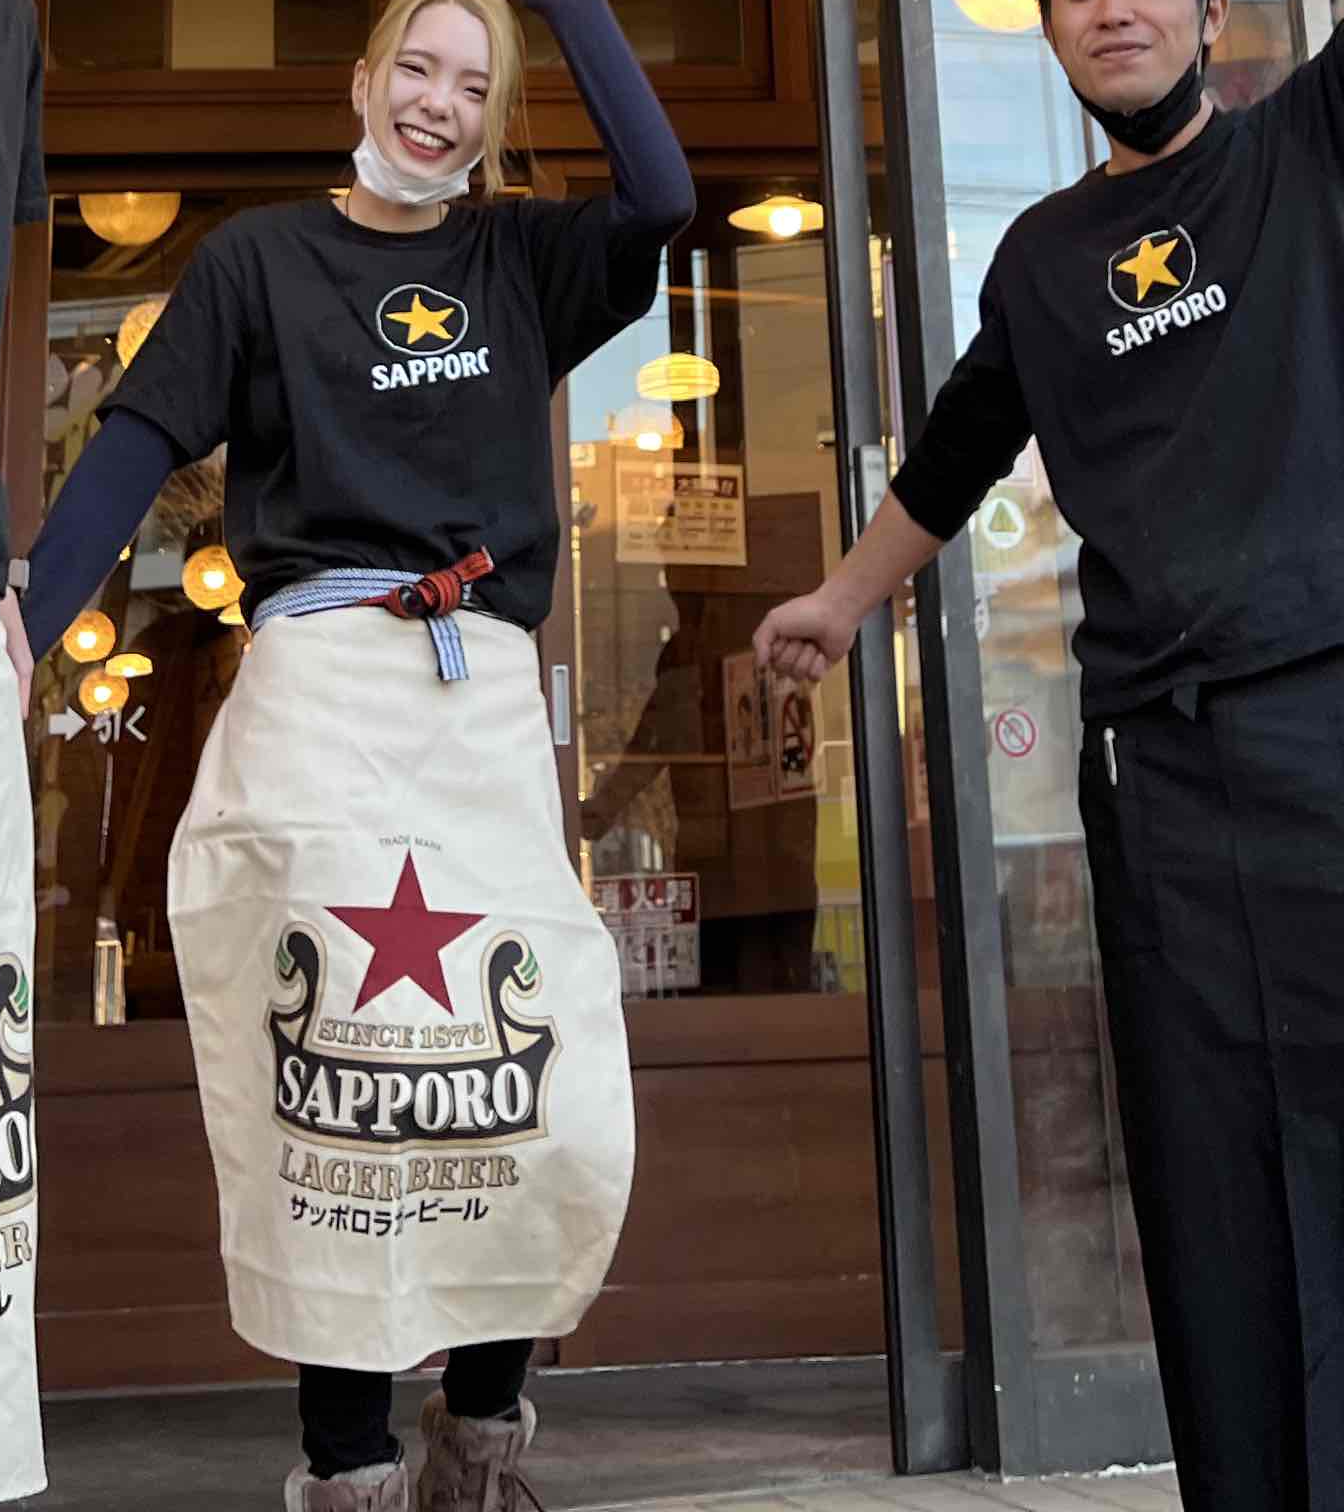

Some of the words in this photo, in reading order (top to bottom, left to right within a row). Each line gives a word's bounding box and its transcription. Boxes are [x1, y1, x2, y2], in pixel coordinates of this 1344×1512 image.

[1105, 283, 1228, 357] SAPPORO
[91, 705, 148, 744] 引く
[318, 1017, 414, 1049] SINCE
[418, 1021, 486, 1050] 1876
[278, 1055, 535, 1136] SAPPORO
[279, 1140, 403, 1201] LAGER
[405, 1153, 521, 1194] BEER
